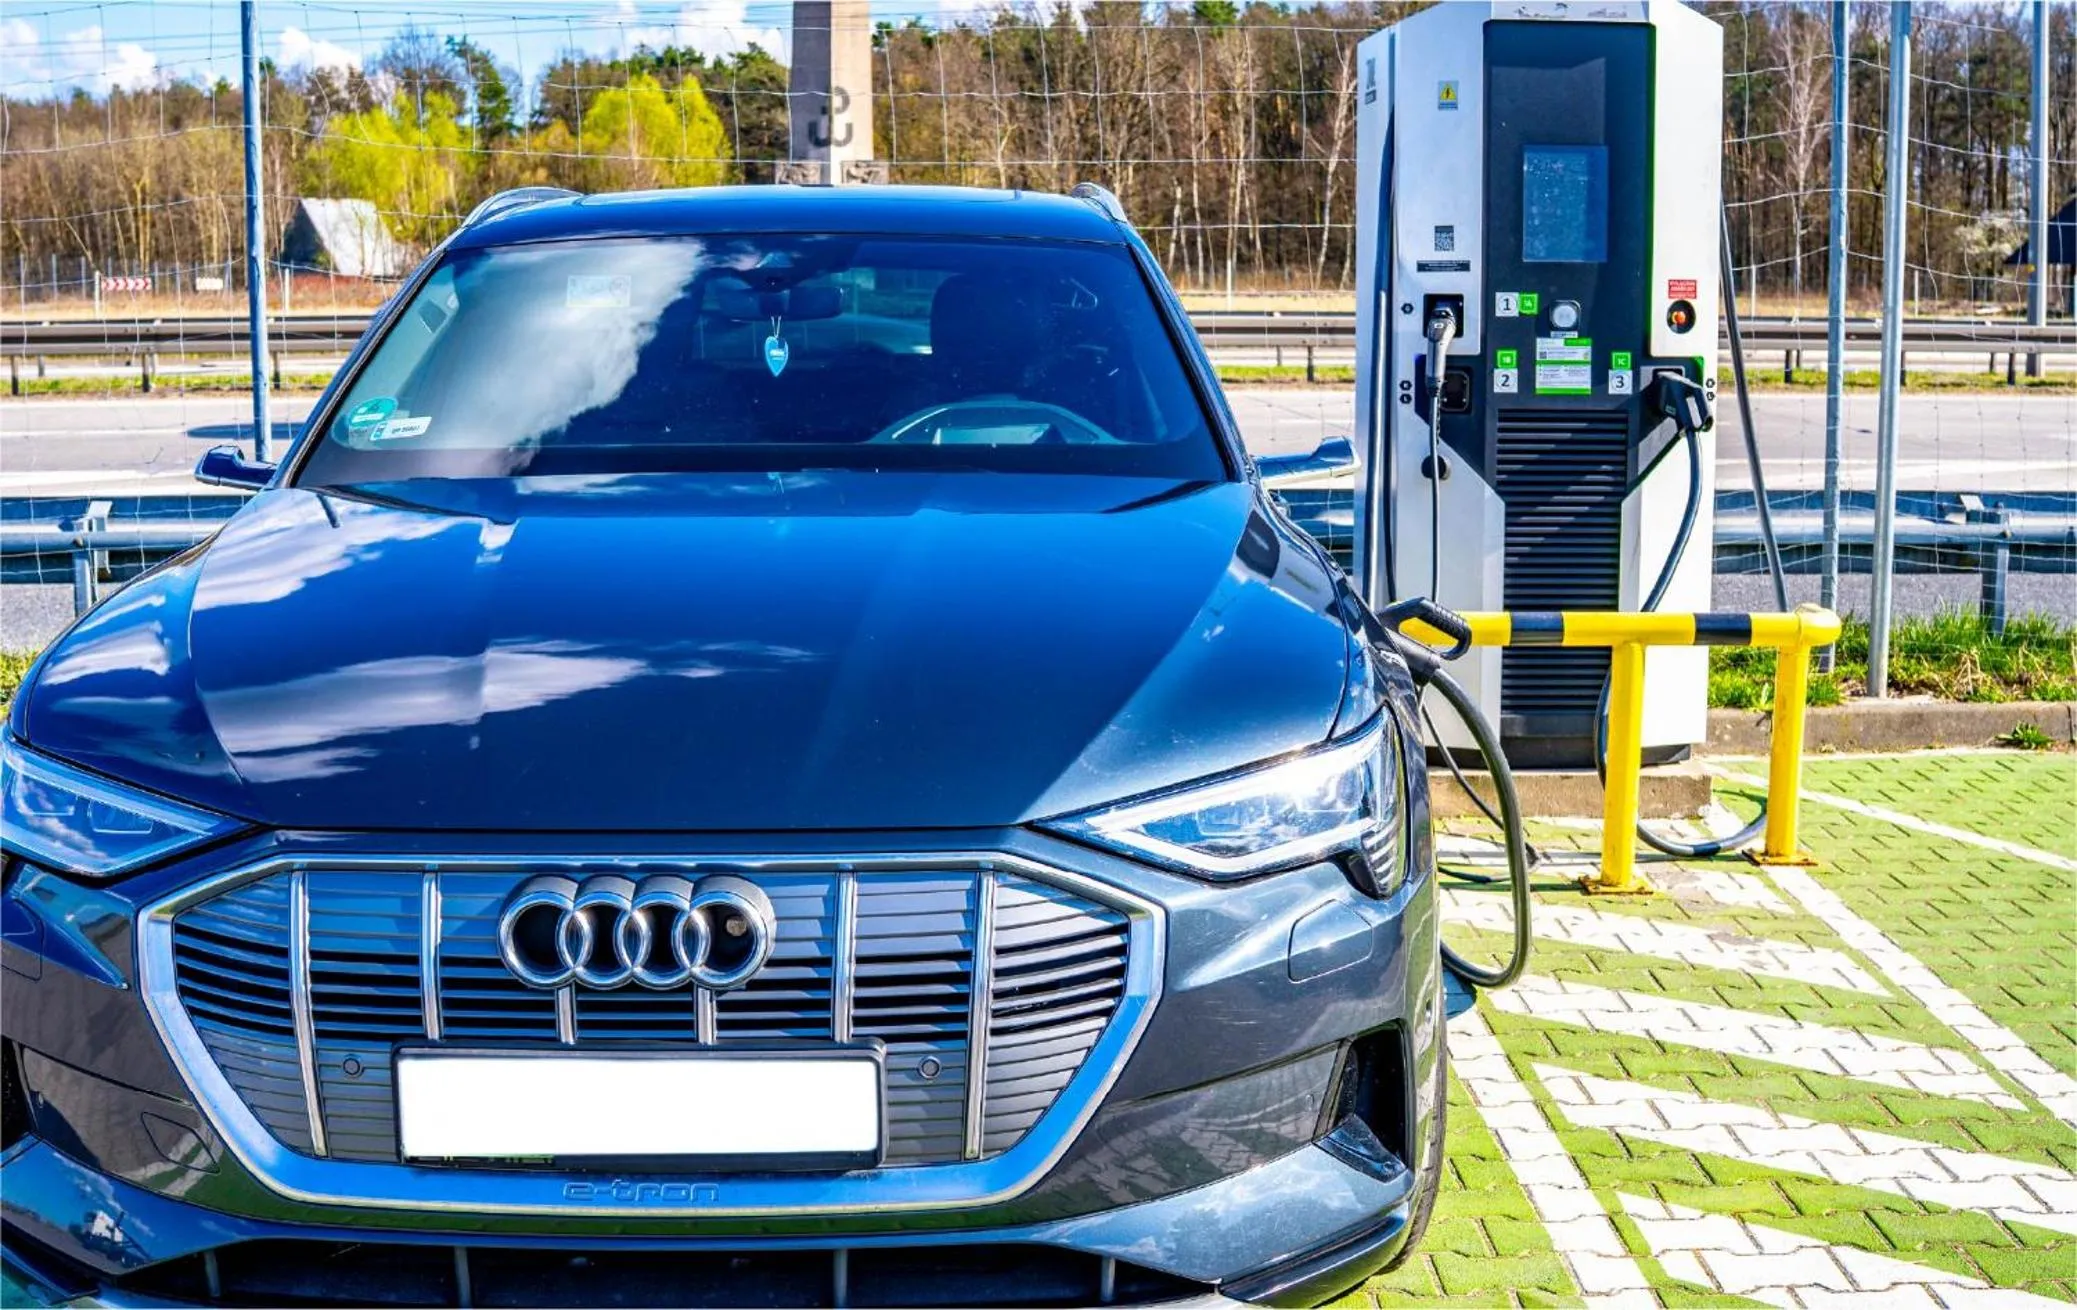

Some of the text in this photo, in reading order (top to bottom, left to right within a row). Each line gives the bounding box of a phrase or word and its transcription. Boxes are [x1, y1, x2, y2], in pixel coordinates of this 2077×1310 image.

[1503, 298, 1511, 311] 1
[1501, 374, 1510, 387] 2
[1615, 375, 1624, 388] 3
[563, 1179, 719, 1201] e-tron
